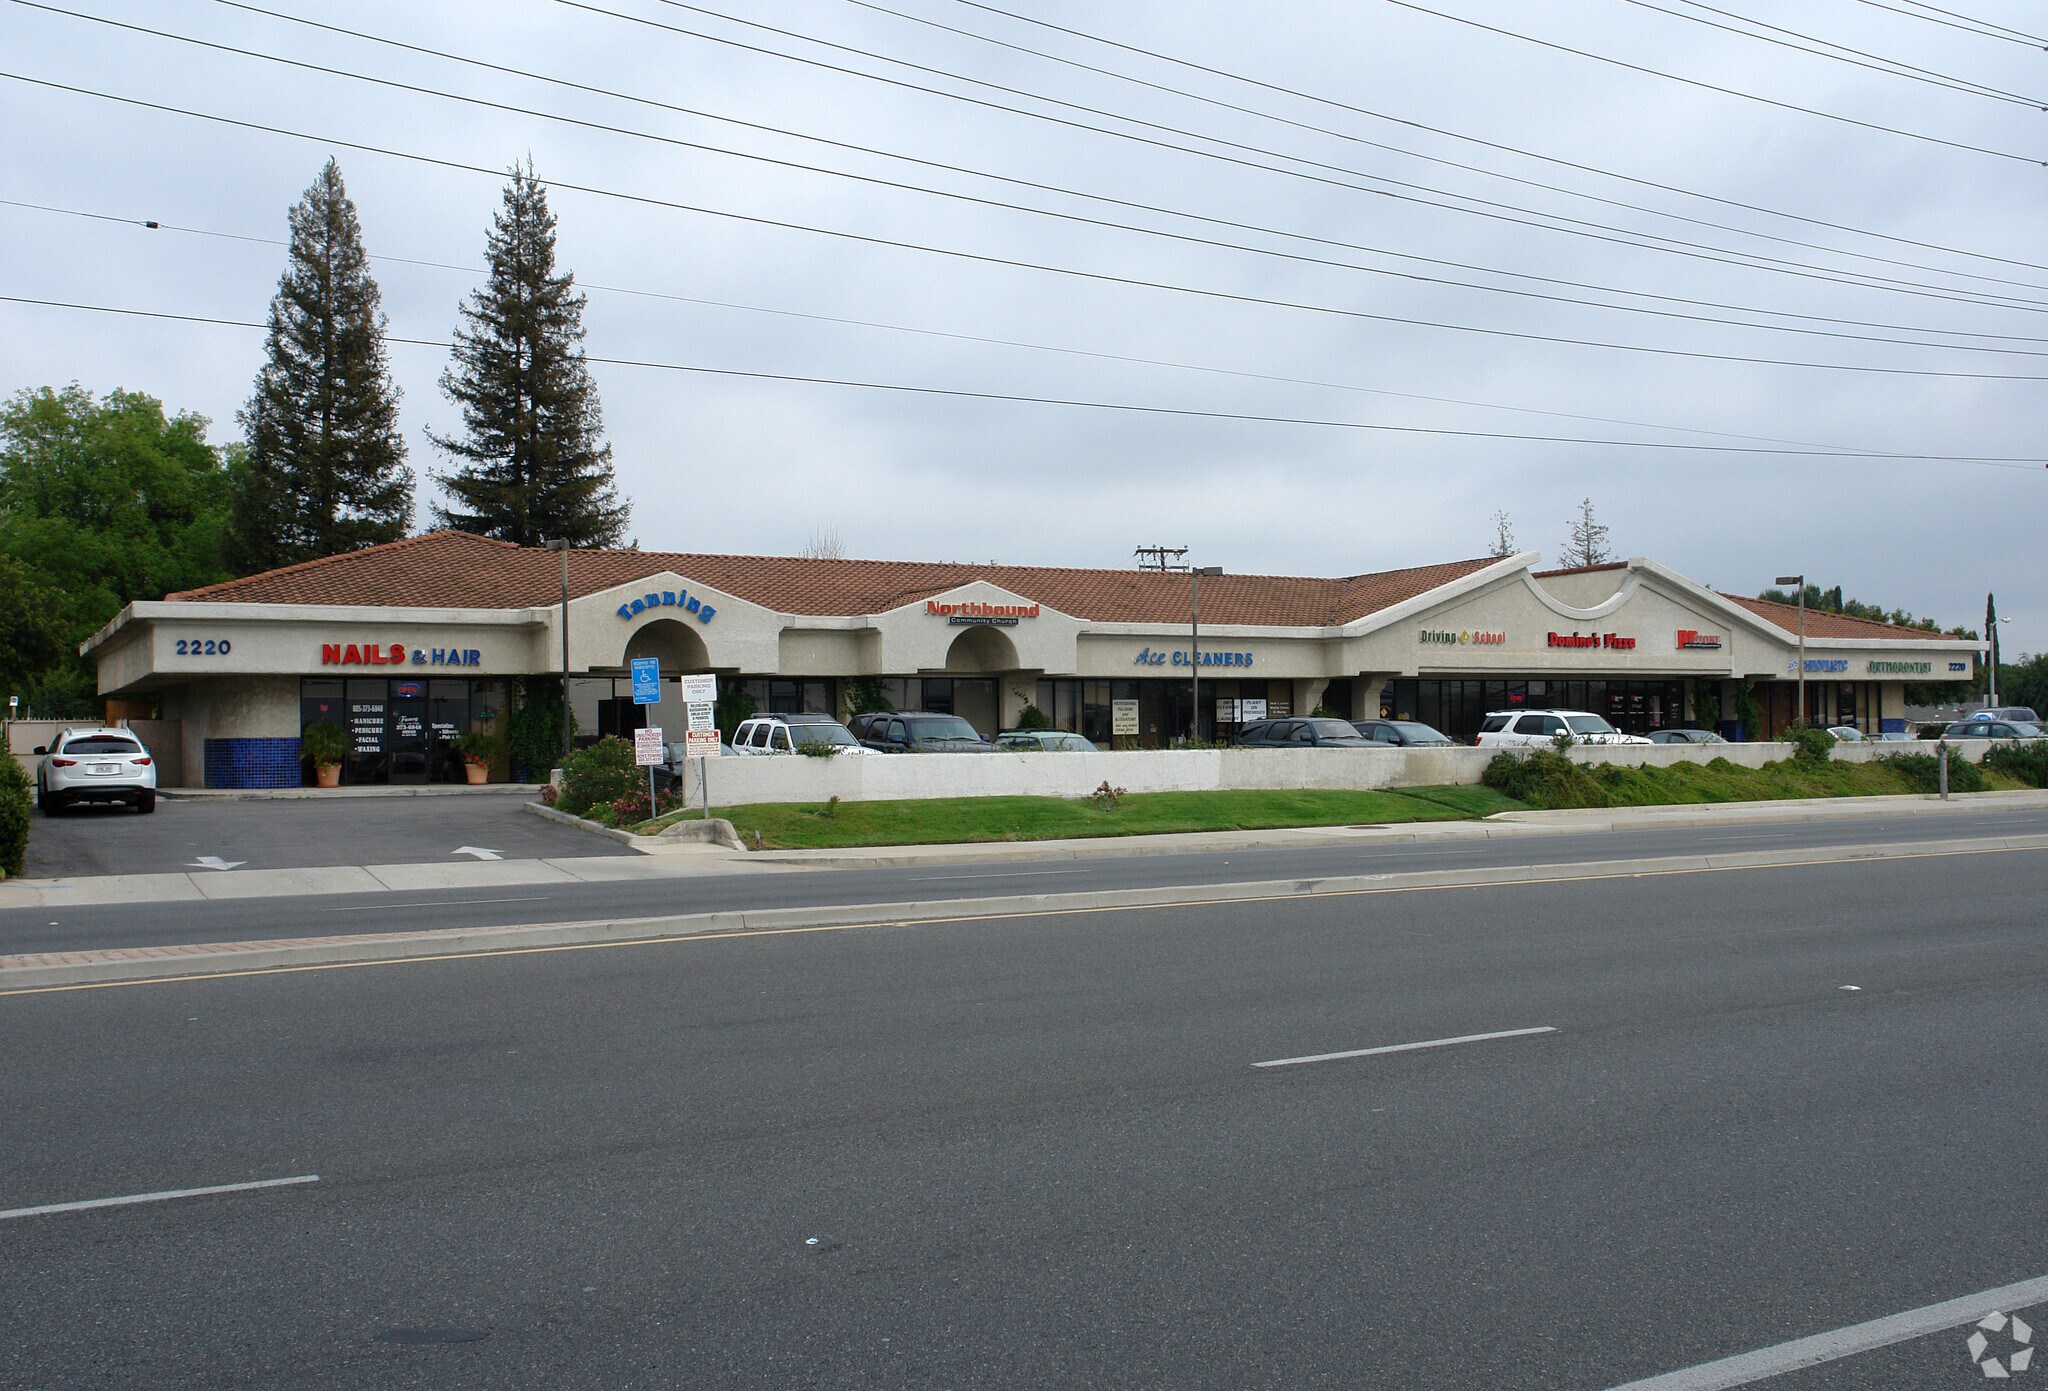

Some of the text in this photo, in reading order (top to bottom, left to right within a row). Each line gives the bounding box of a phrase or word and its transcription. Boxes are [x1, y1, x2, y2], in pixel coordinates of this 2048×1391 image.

[617, 589, 717, 624] Tanning
[926, 600, 1040, 617] Northbound
[950, 617, 990, 625] Community
[1420, 630, 1506, 645] Driving School
[1548, 631, 1636, 649] Domino's Pizza
[176, 639, 232, 656] 2220
[322, 643, 481, 666] NAILS & HAIR
[1134, 647, 1254, 667] Ace CLEANERS
[1803, 659, 1849, 672] HIROPRACTIC
[1868, 660, 1932, 673] ORTHODONTIST
[1948, 662, 1967, 672] 2220
[398, 686, 418, 694] OPEN
[353, 717, 384, 725] MANICURE
[357, 745, 381, 753] WAXING
